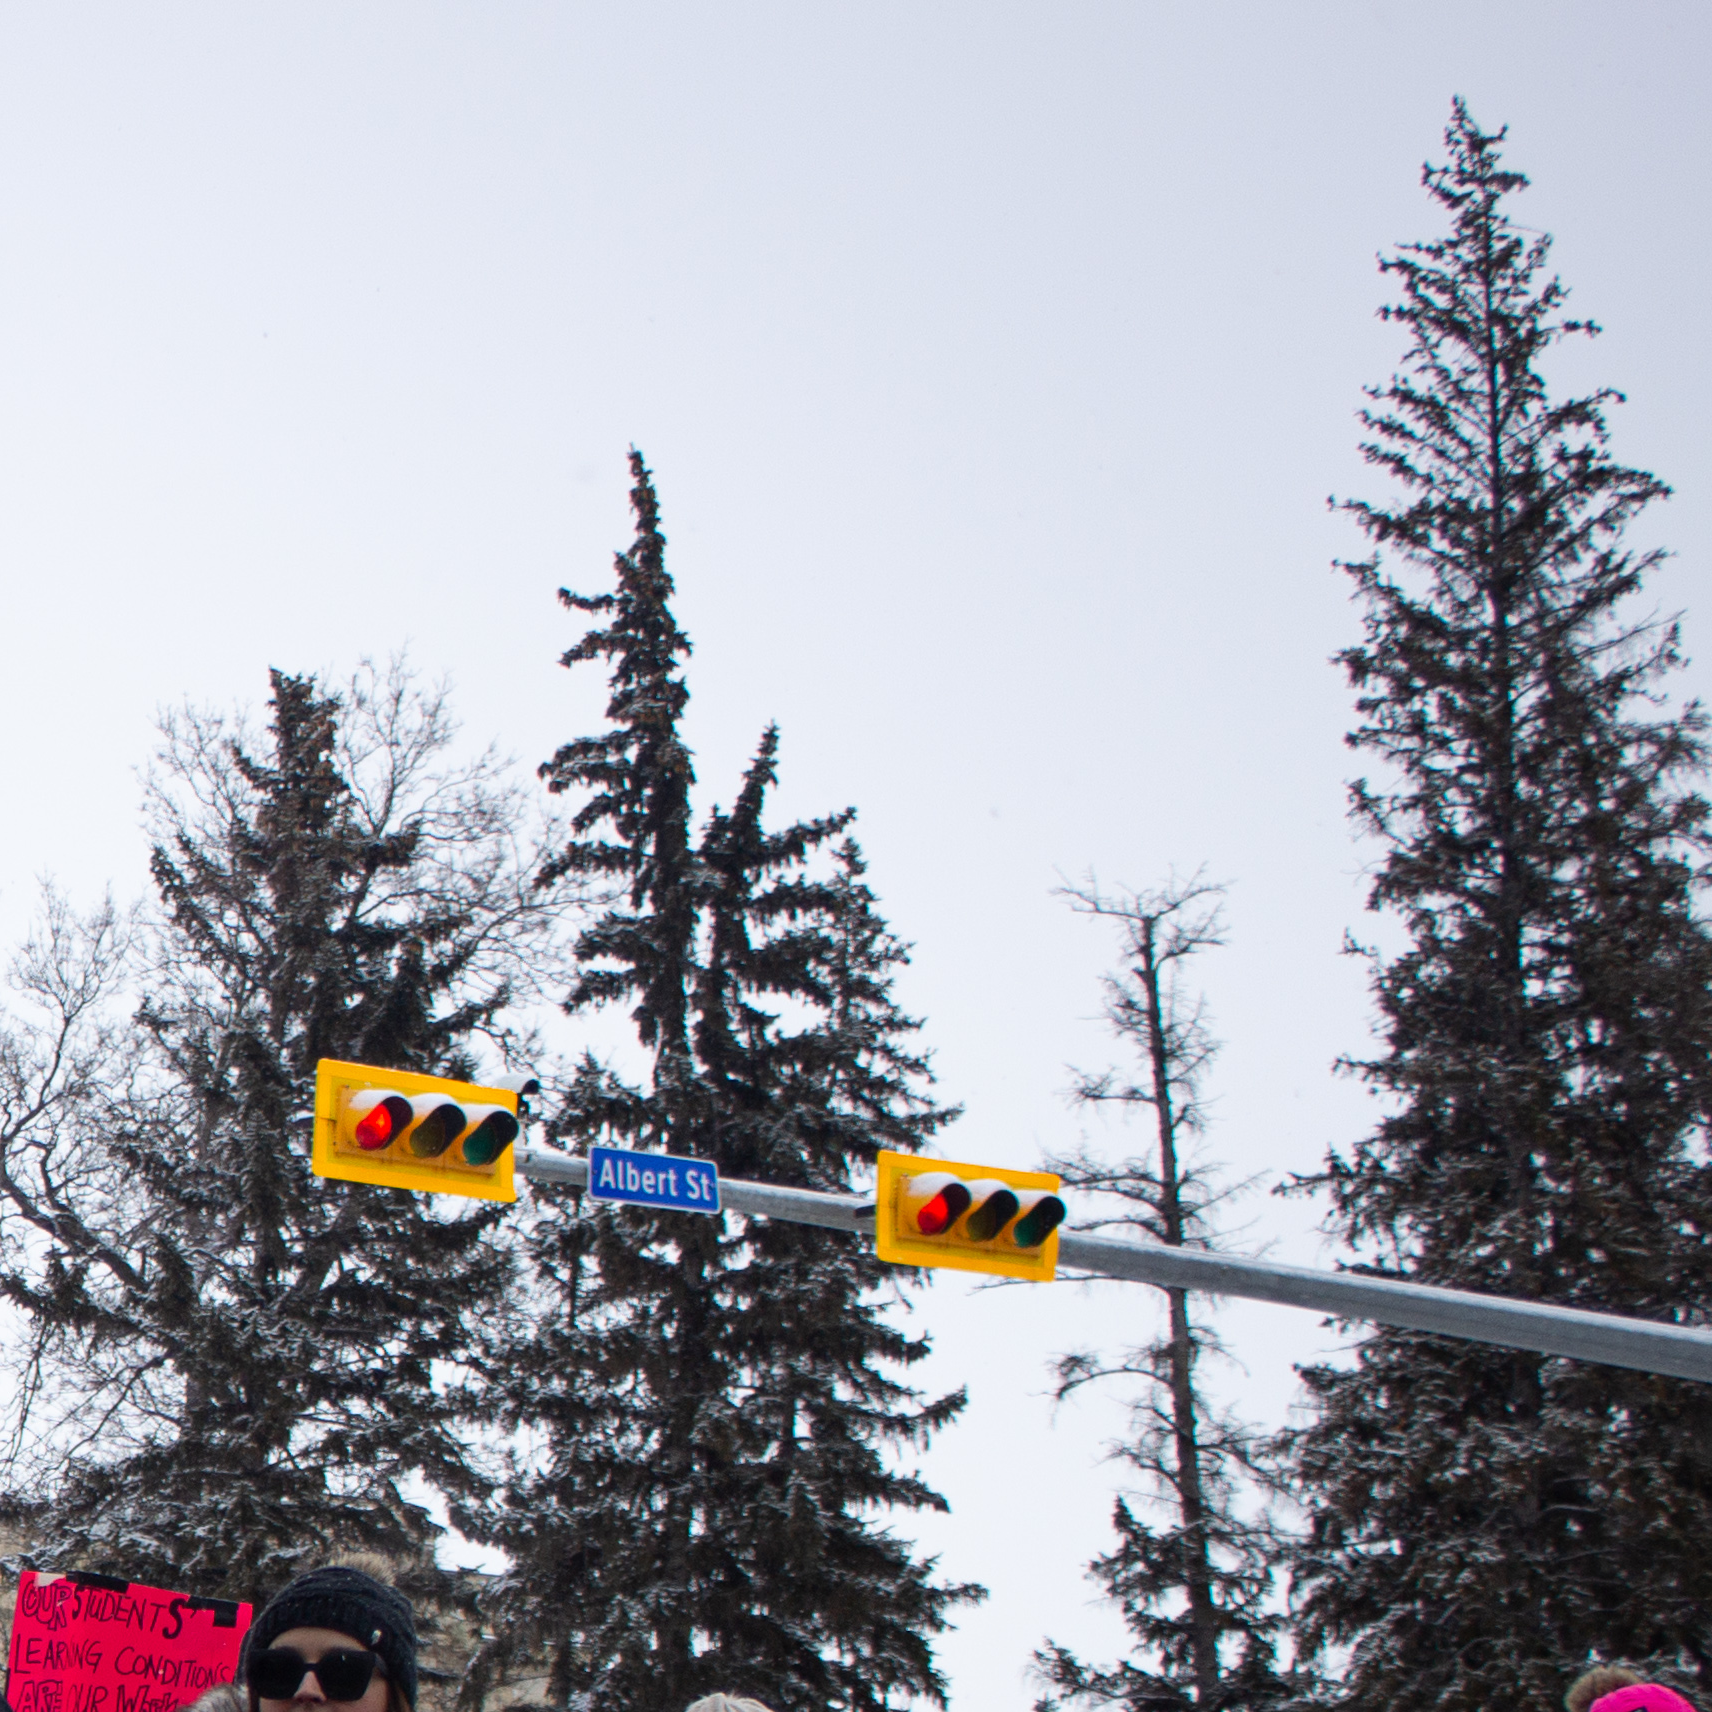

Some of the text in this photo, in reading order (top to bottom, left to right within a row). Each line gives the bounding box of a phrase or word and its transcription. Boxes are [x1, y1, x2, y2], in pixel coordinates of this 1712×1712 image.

[599, 1158, 711, 1201] Albert St
[21, 1580, 73, 1632] OUR
